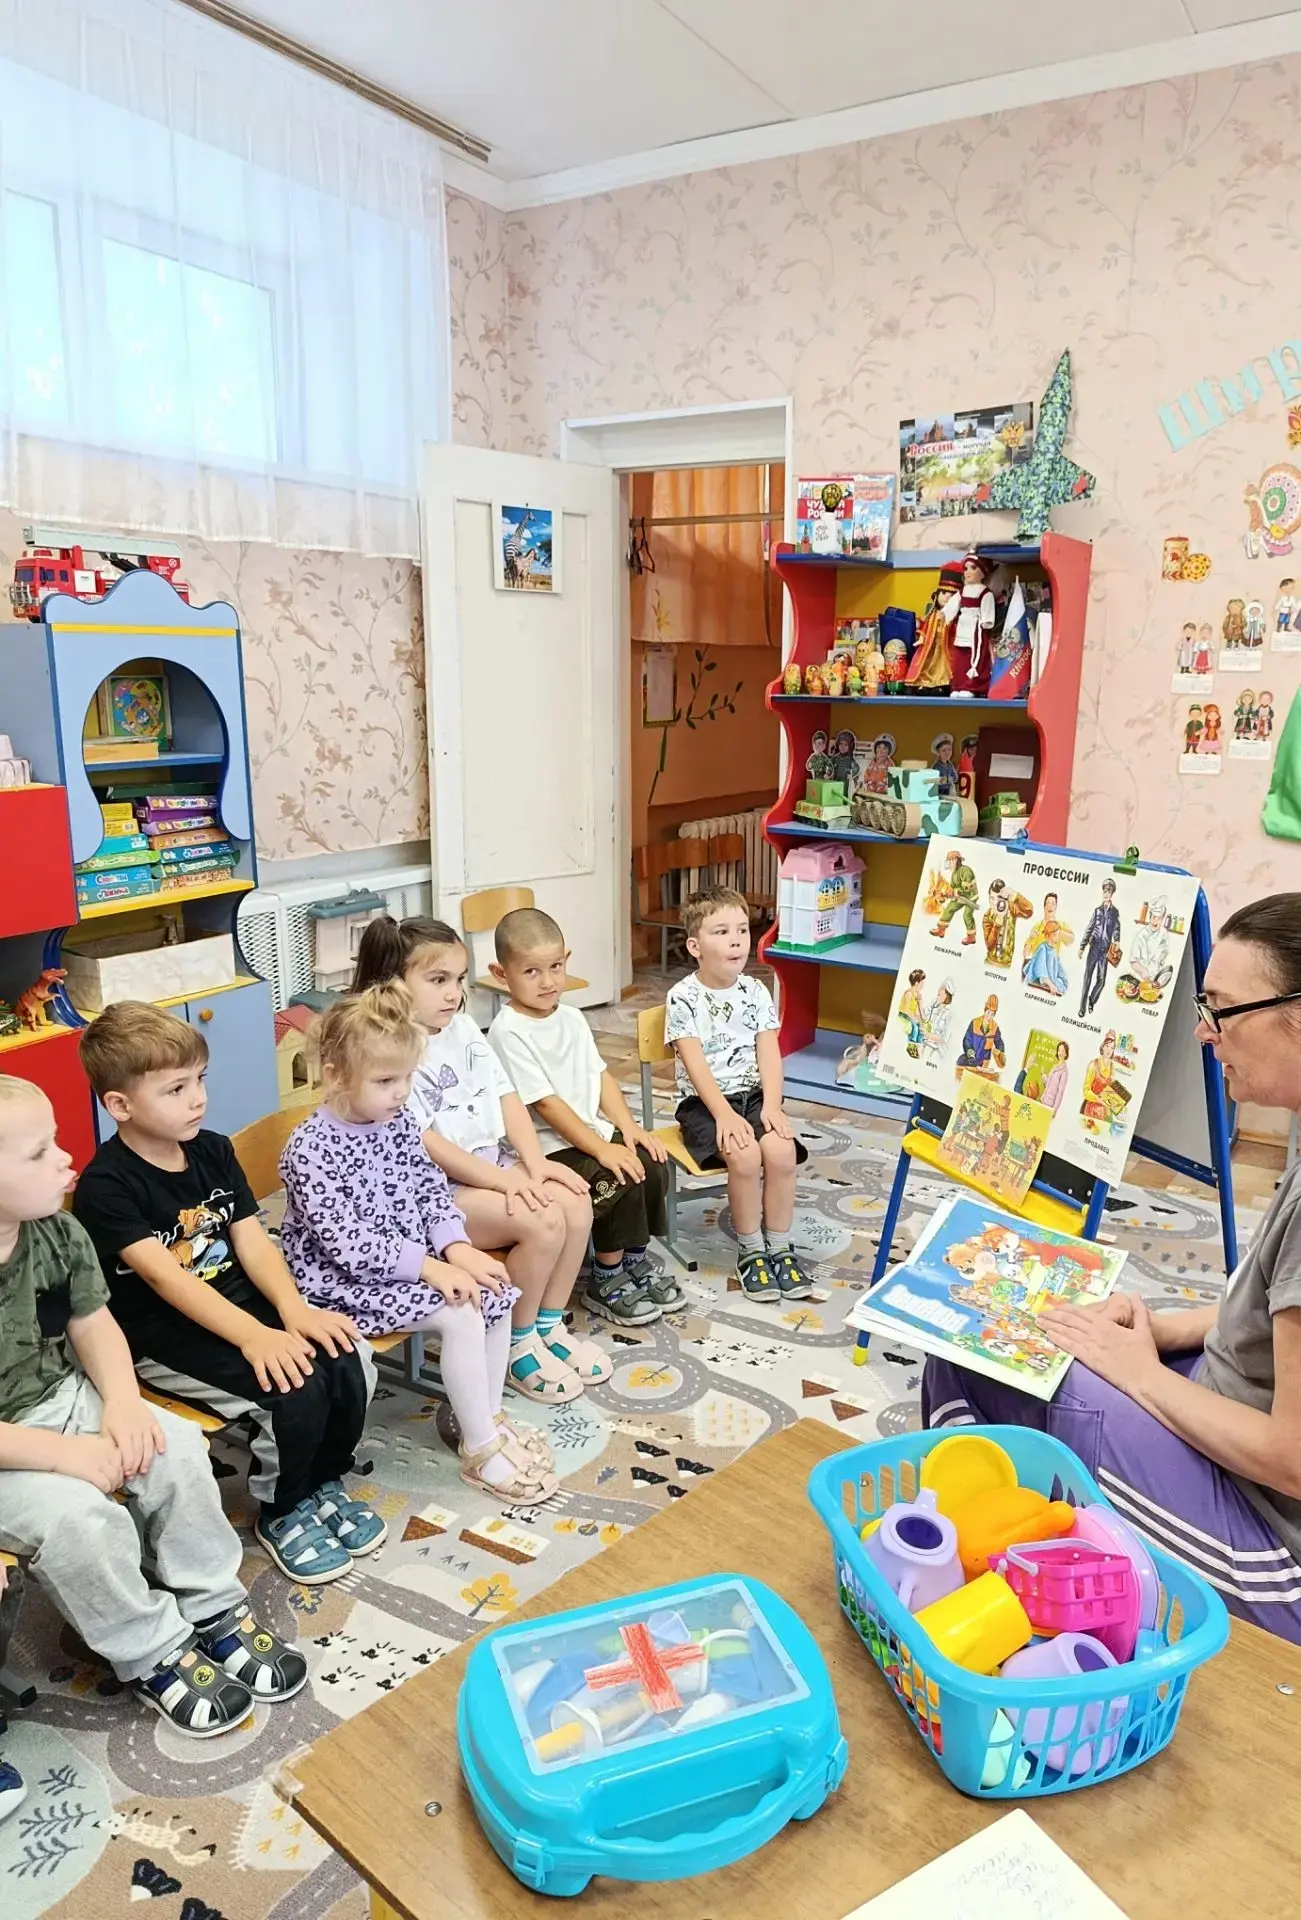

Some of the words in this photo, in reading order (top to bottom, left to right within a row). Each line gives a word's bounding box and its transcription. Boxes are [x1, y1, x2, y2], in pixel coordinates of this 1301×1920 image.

[1023, 862, 1090, 885] ПРОФЕССИИ
[1024, 992, 1057, 1006] ПАРИКМАХЕР
[1141, 1007, 1159, 1018] ПОВАР
[1061, 1015, 1102, 1034] ПОЛИЦЕЙСКИЙ
[1084, 1137, 1110, 1155] ПРОДАВЕЦ
